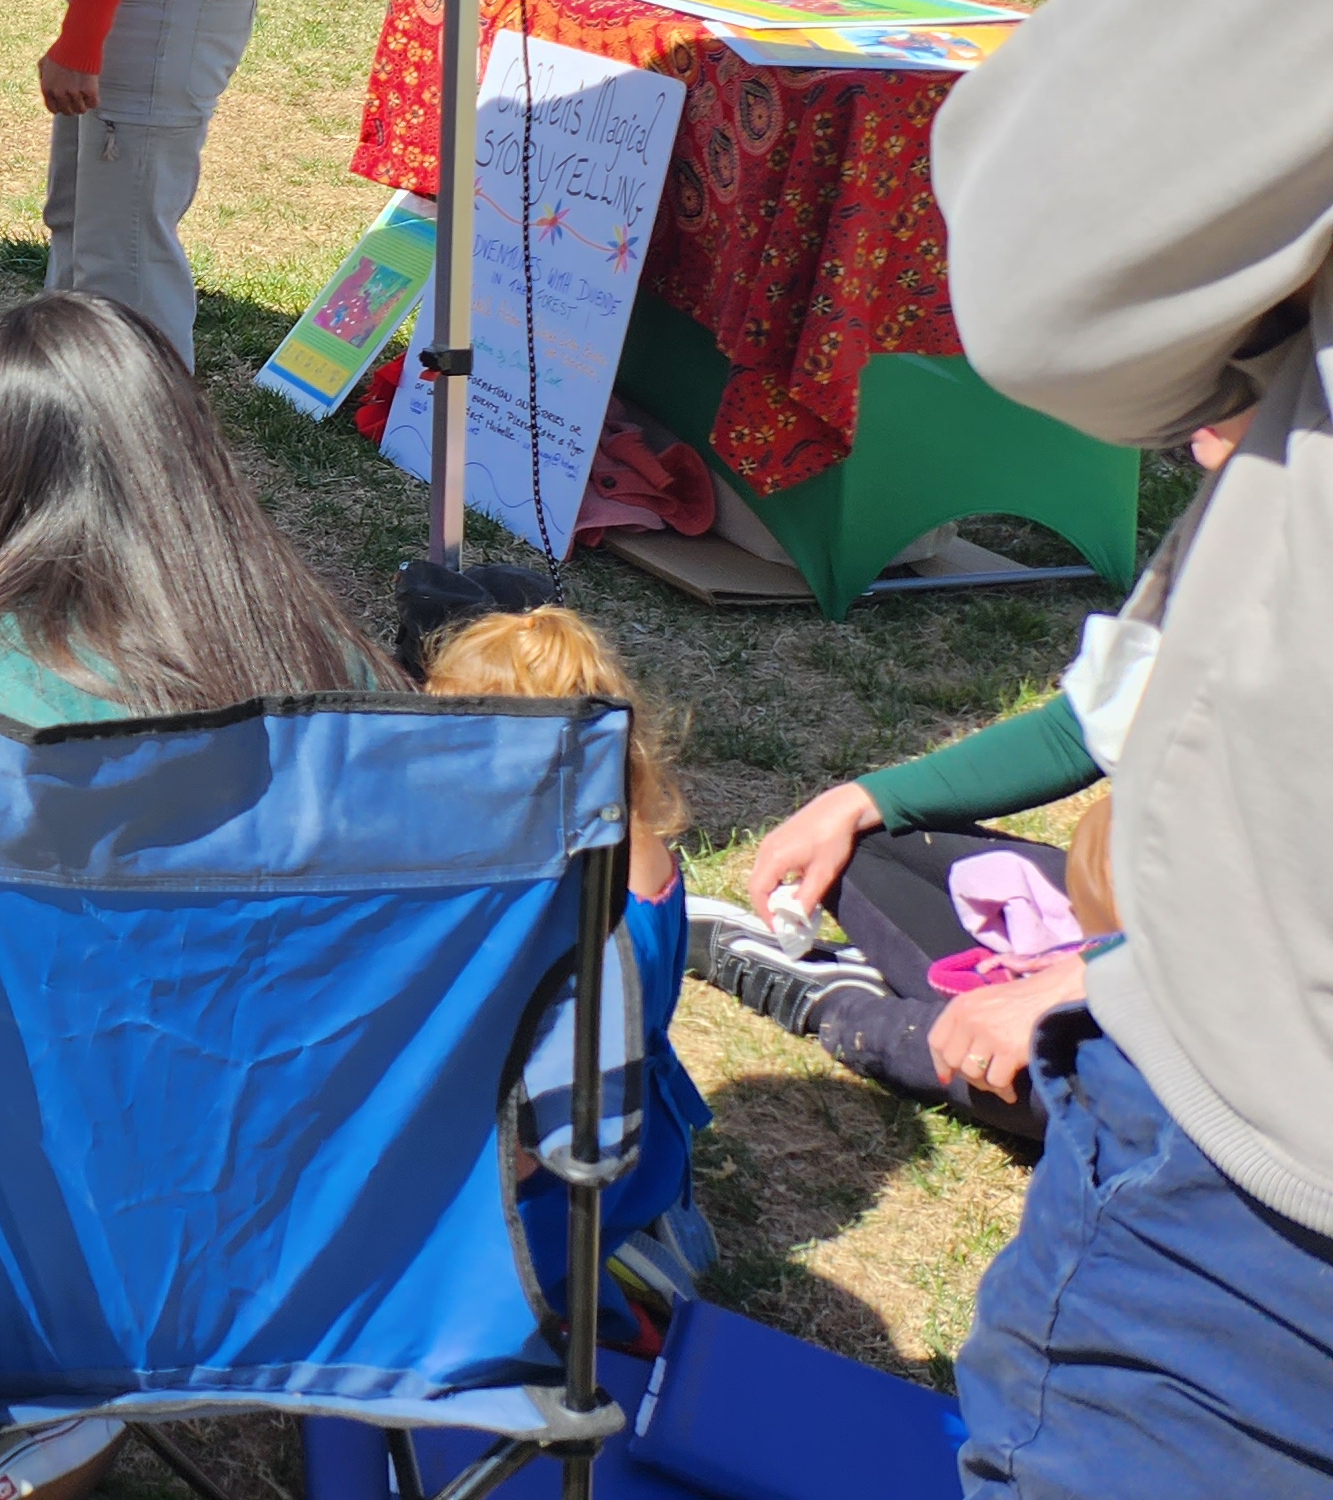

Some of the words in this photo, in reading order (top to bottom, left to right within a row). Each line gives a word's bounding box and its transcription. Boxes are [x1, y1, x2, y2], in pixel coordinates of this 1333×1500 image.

[586, 74, 666, 173] Magical
[475, 129, 646, 228] STORYTELLING
[536, 289, 578, 321] FOREST
